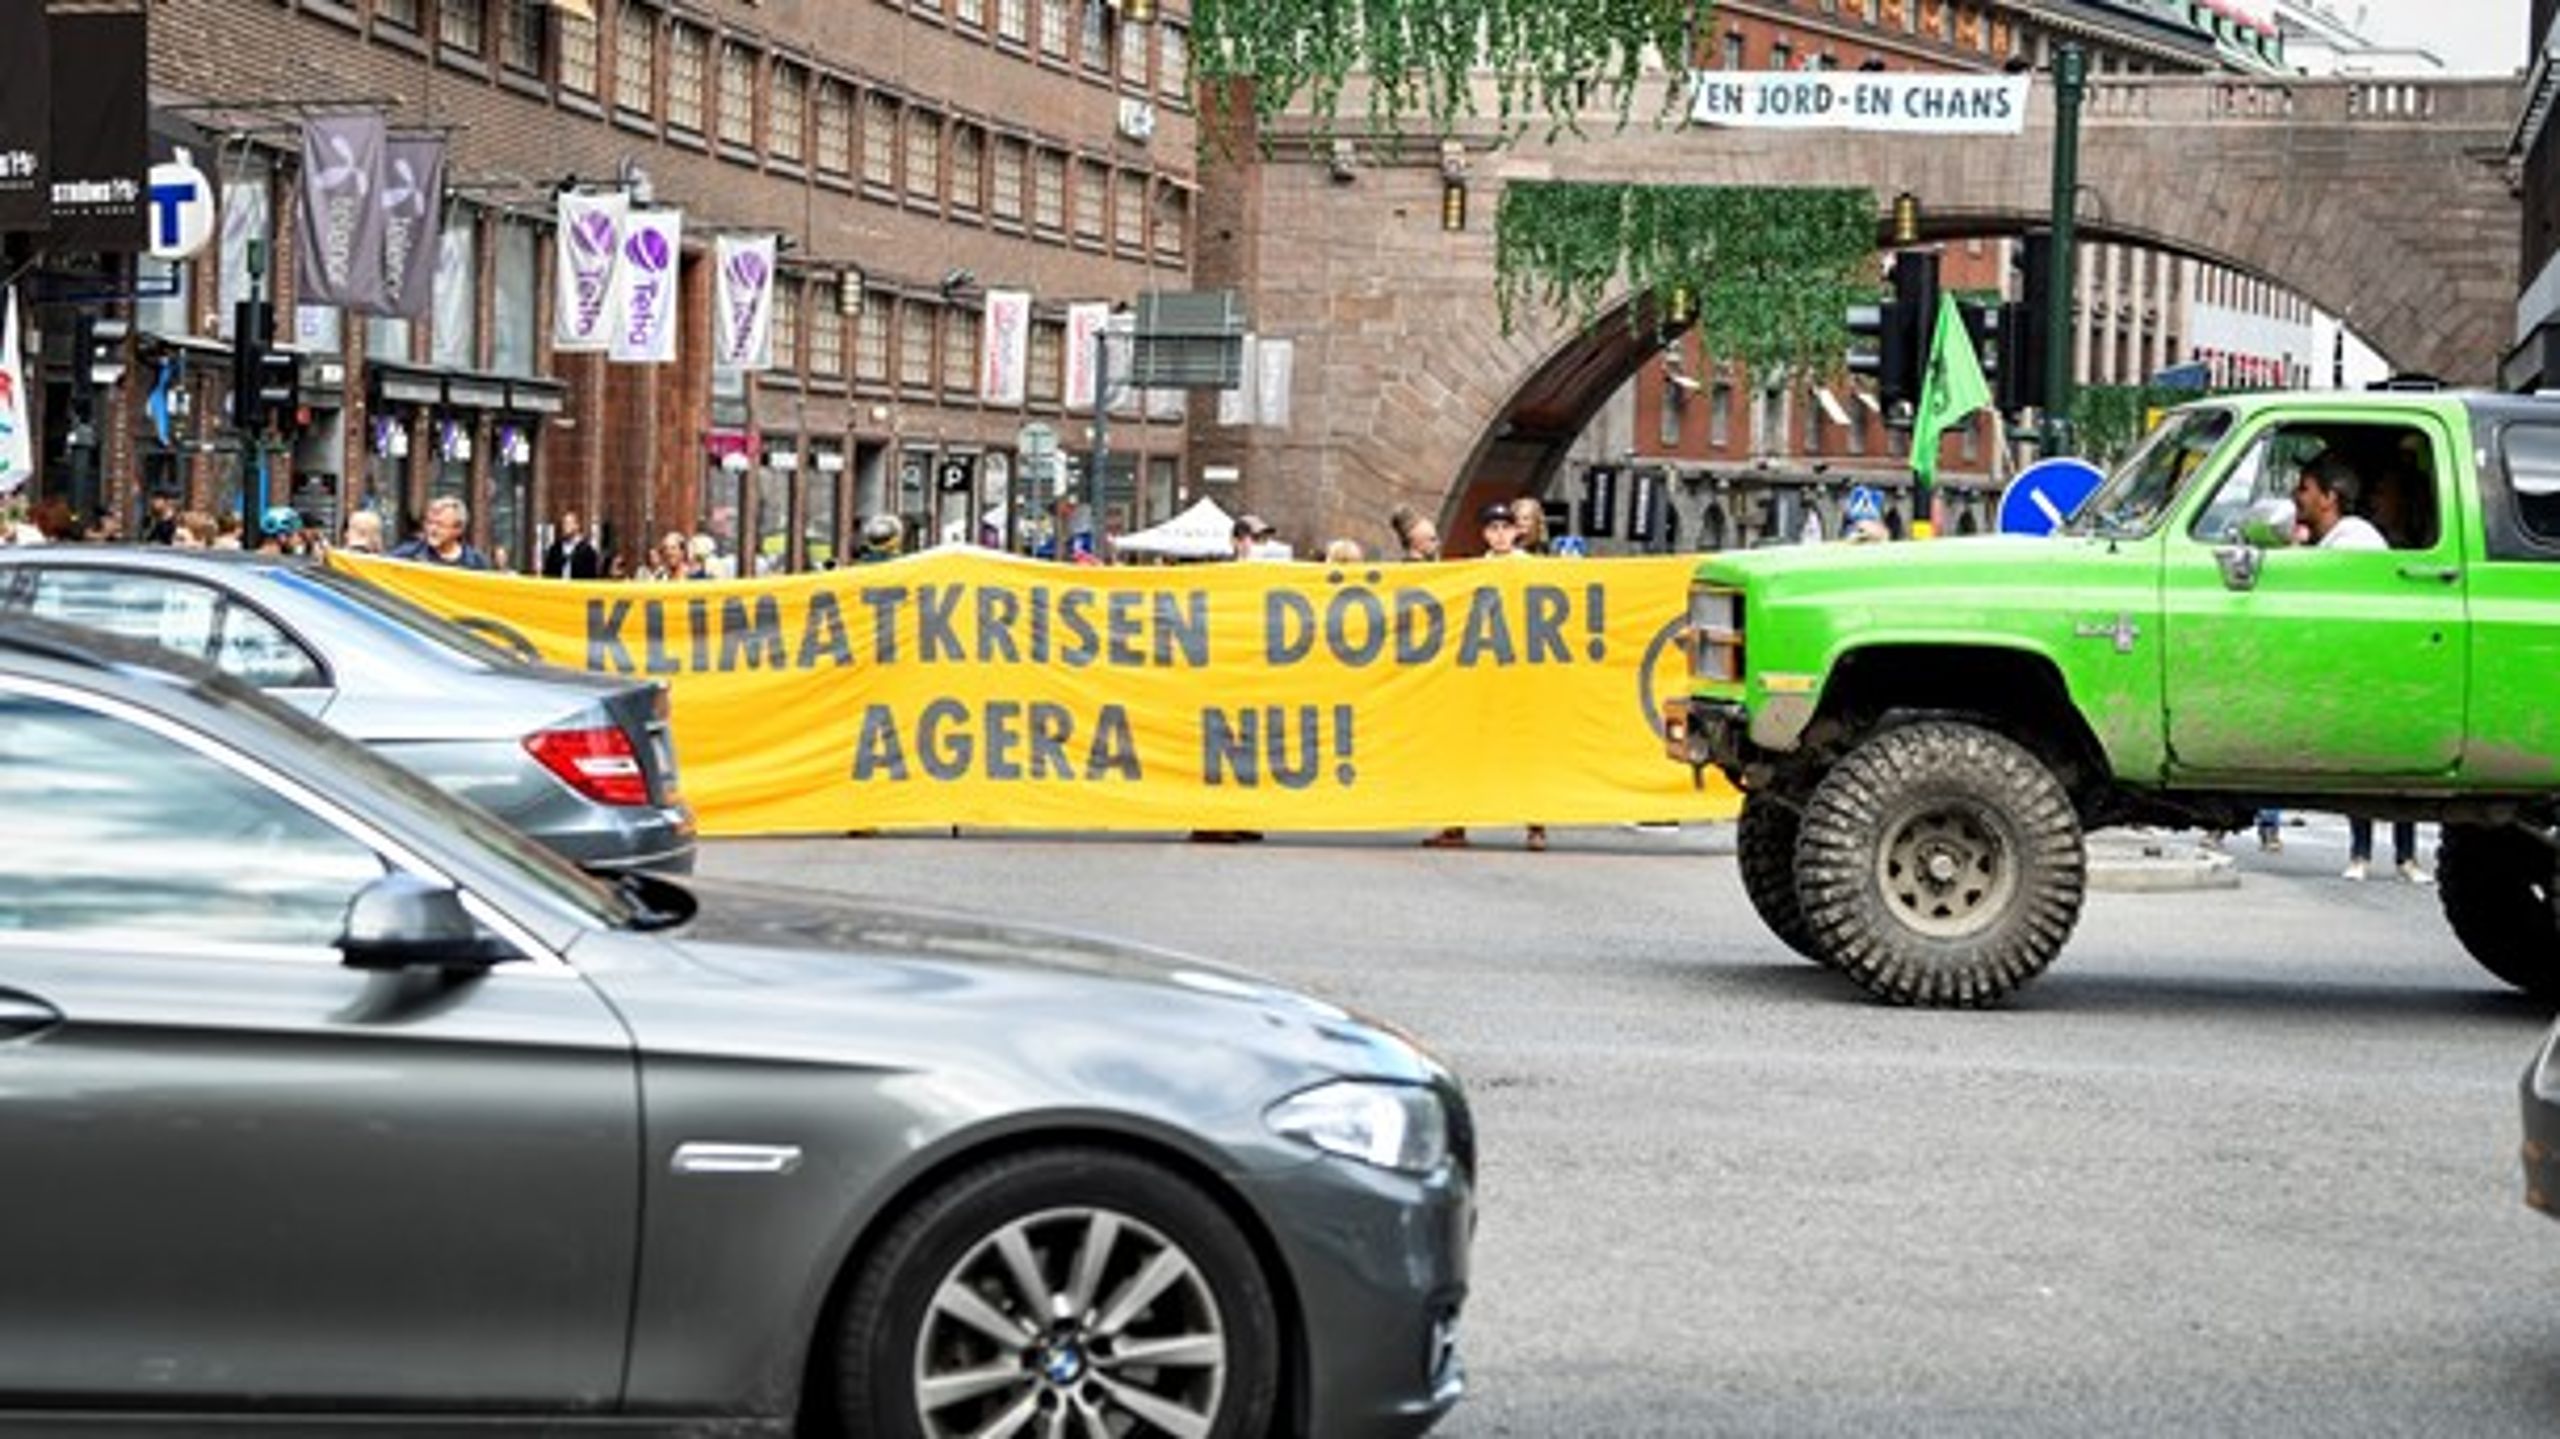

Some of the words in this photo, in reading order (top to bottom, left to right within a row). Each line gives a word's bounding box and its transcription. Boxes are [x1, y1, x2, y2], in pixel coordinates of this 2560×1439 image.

[1707, 83, 1743, 115] EN
[1903, 86, 2011, 119] CHANS
[149, 183, 197, 248] T
[628, 279, 659, 346] Telia
[585, 582, 1210, 674] KLIMATKRISEN
[1265, 570, 1608, 667] DÖDAR!
[852, 698, 1143, 782] AGERA
[1201, 704, 1358, 789] NU!
